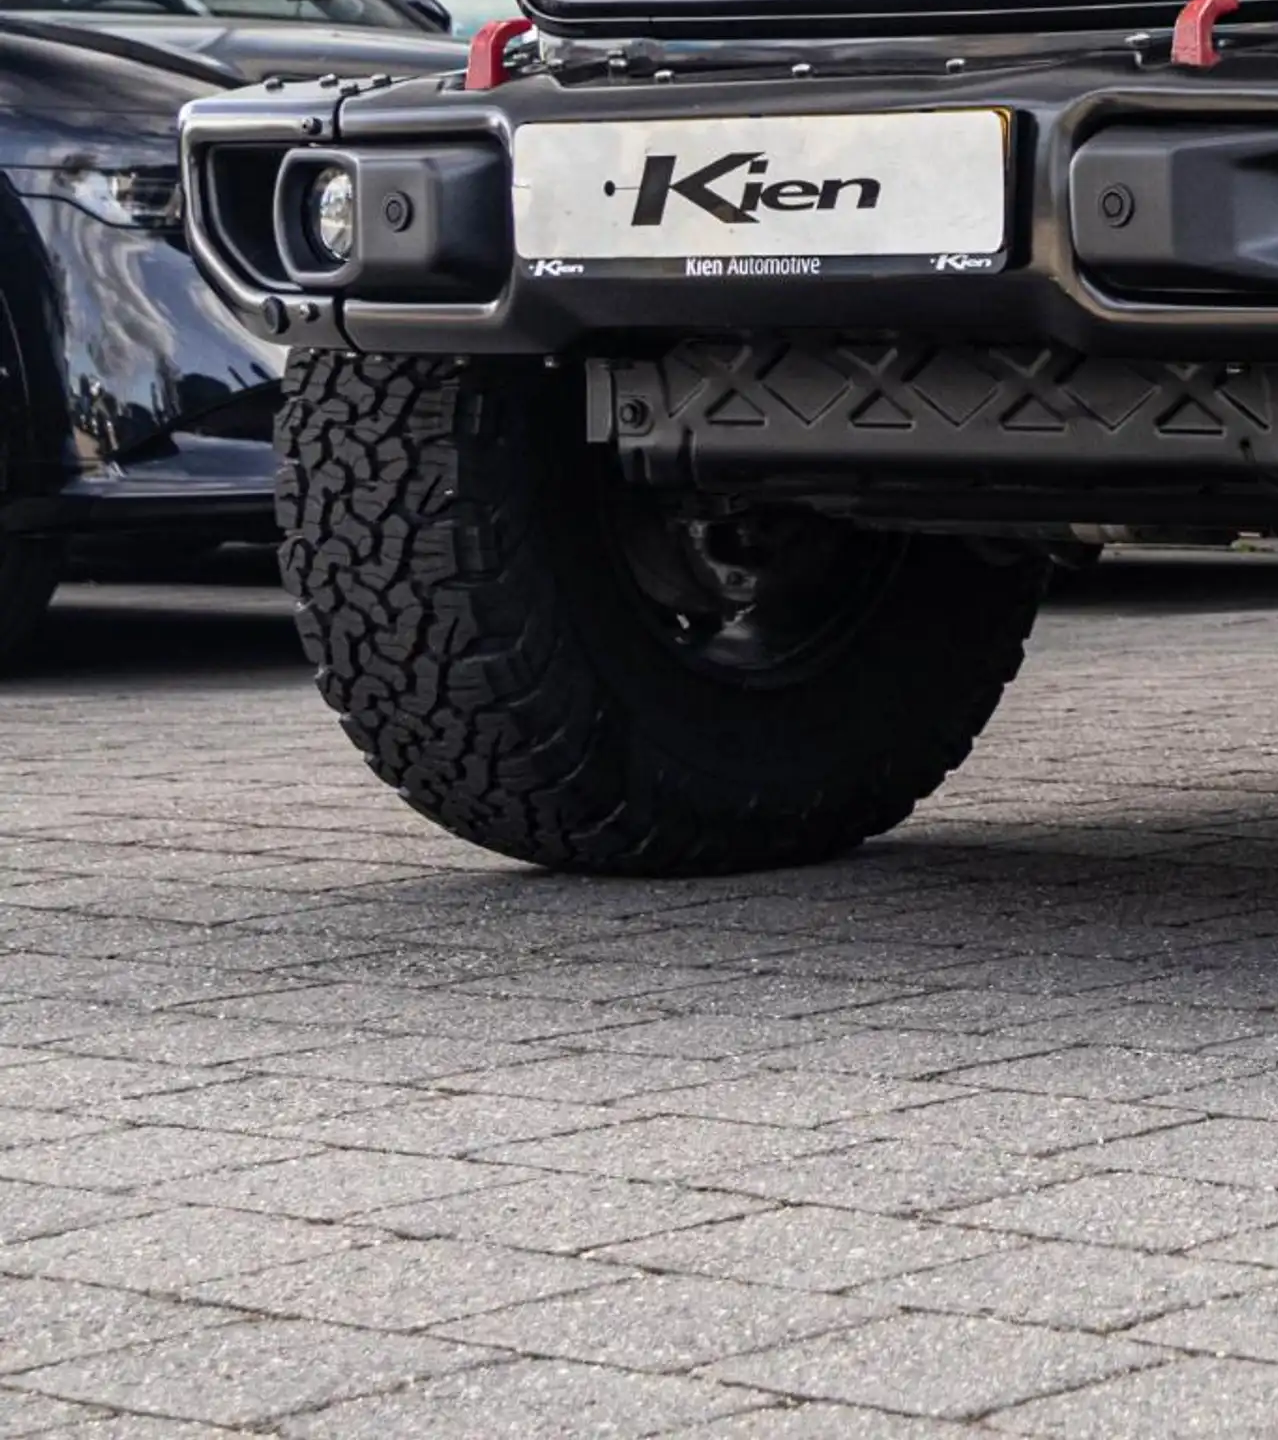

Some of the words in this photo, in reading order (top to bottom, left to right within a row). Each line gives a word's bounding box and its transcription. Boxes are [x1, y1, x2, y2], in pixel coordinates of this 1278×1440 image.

[630, 151, 881, 225] Kien
[533, 259, 585, 277] Kien
[685, 257, 722, 276] Kien
[726, 255, 822, 276] Automotive
[935, 254, 992, 271] Kien
